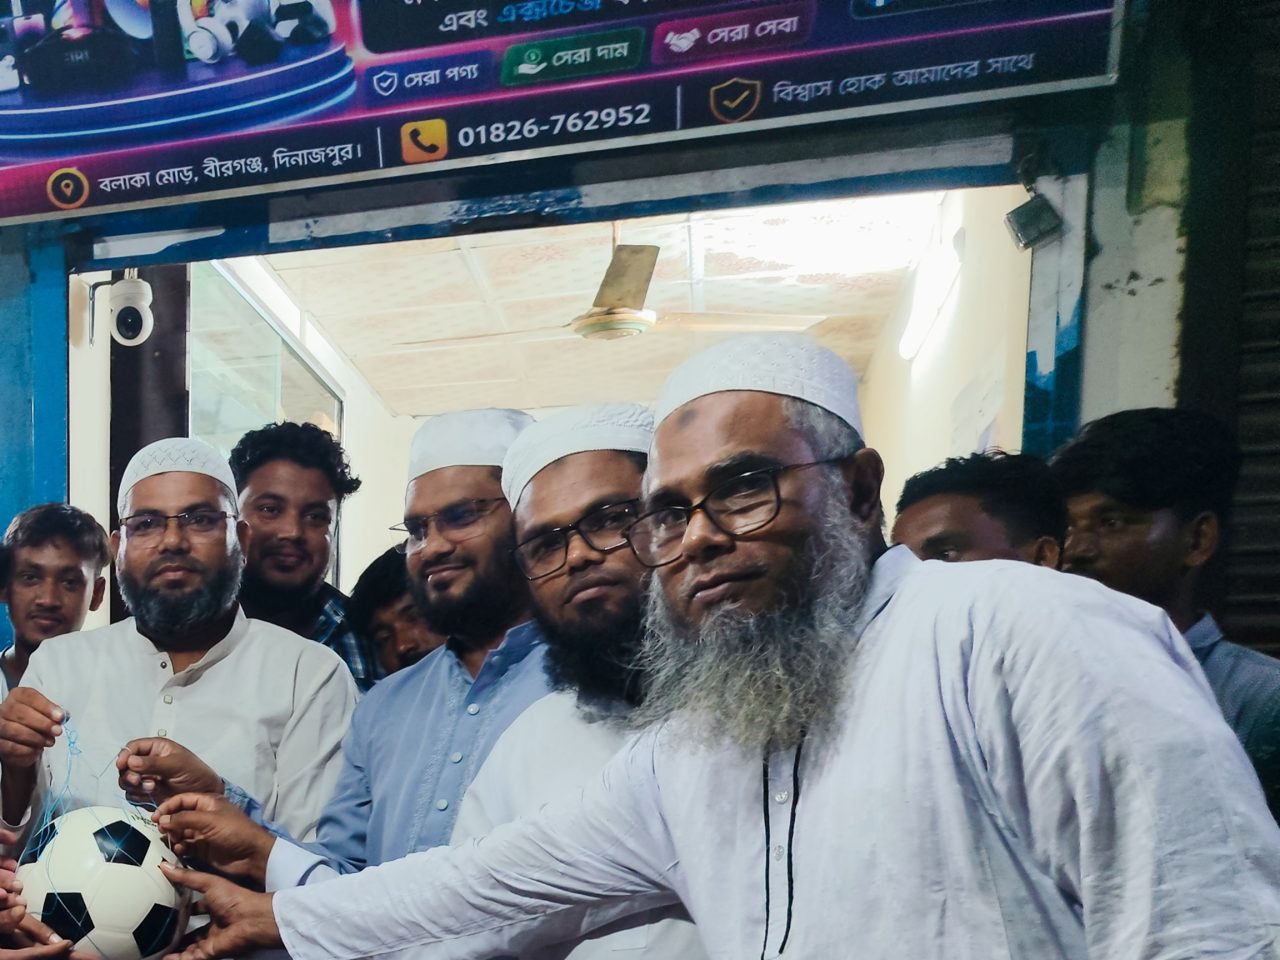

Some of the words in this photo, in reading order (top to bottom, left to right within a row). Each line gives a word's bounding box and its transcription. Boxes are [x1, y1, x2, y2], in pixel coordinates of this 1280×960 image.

[439, 9, 488, 31] এবং
[707, 23, 749, 44] সেরা
[754, 16, 800, 37] সেবা
[552, 47, 591, 67] সেরা
[596, 41, 629, 59] দাম
[404, 69, 440, 89] সেরা
[772, 79, 833, 103] বিশ্বাস
[839, 72, 887, 95] হোক
[892, 59, 980, 86] আমাদের
[986, 52, 1036, 73] সাথে
[458, 103, 652, 147] 01826-762952
[97, 171, 151, 193] বলাকা
